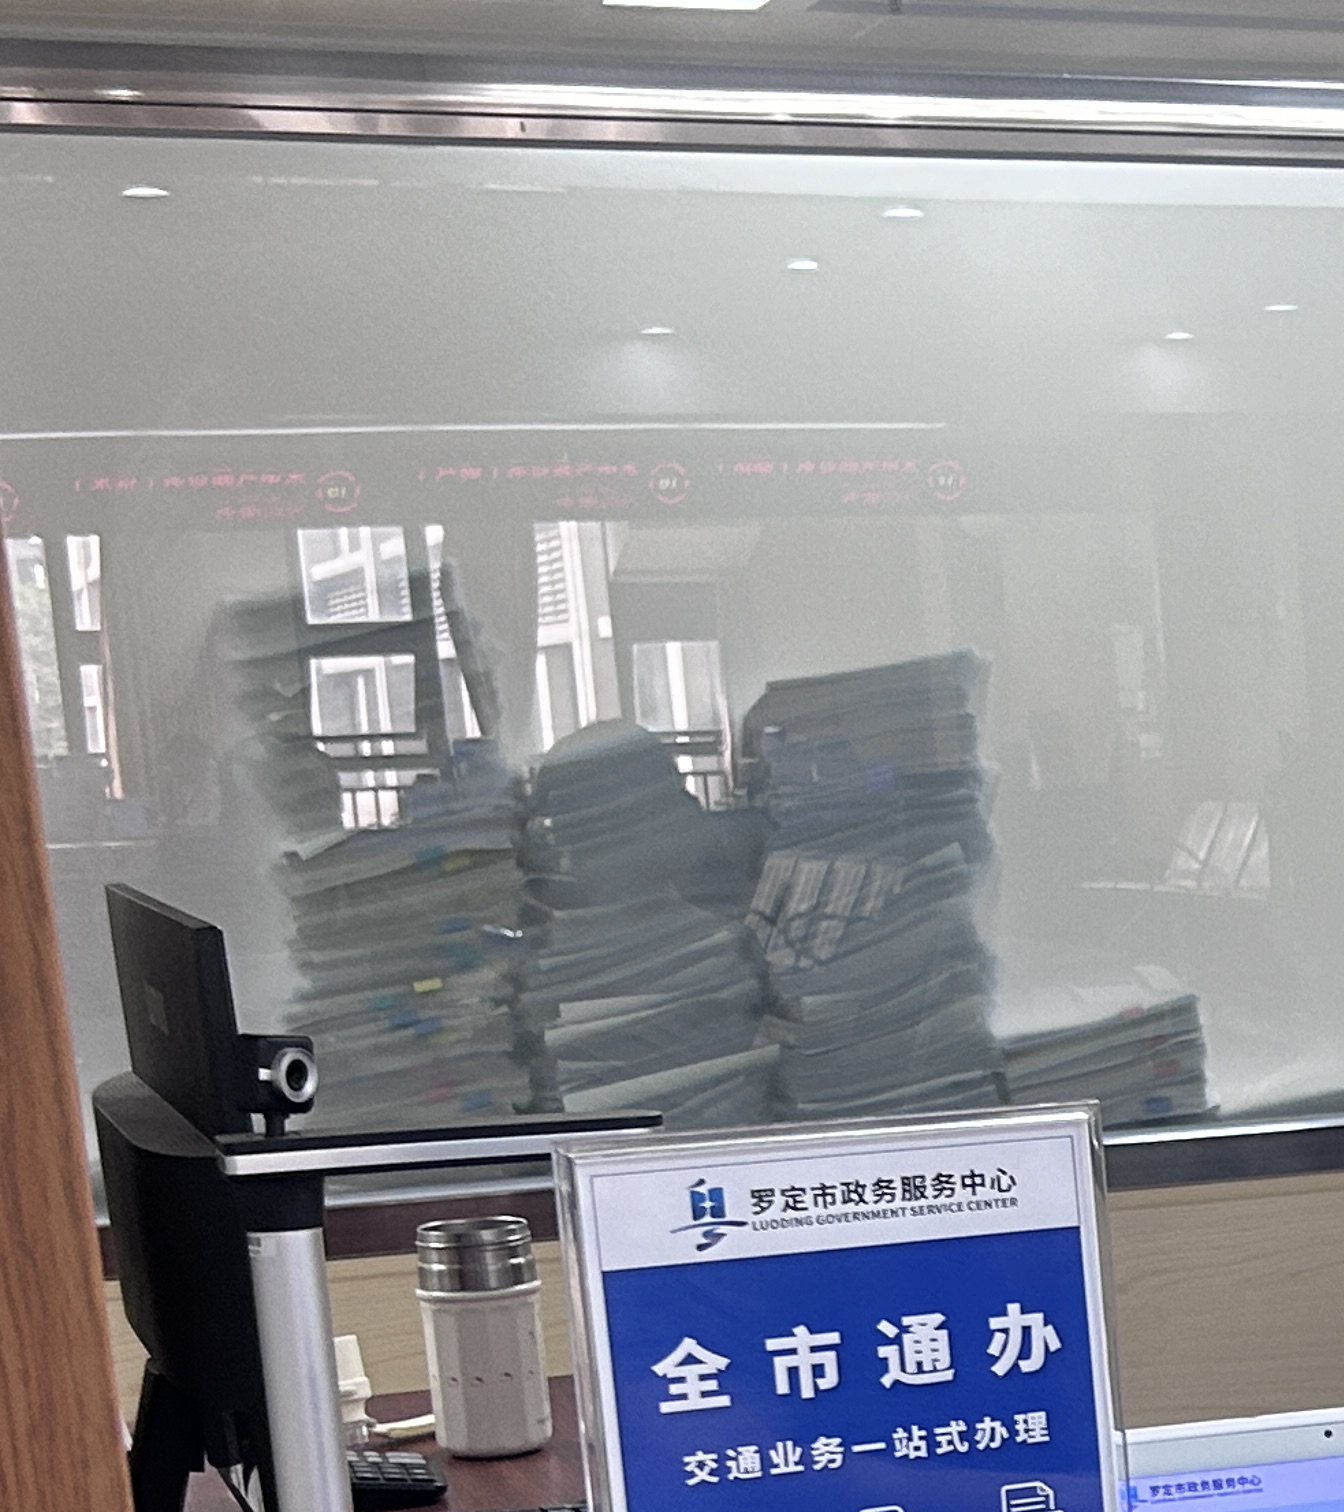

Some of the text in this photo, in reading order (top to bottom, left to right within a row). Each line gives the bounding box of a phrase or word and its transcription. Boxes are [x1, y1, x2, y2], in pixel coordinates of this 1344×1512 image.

[750, 1167, 1018, 1215] 罗定市政务服务中心
[752, 1197, 1019, 1232] LUODING GOVERNMENT SERVICE CENTER
[651, 1303, 1062, 1414] 全市通办
[683, 1411, 1052, 1486] 交通业务一站式办理
